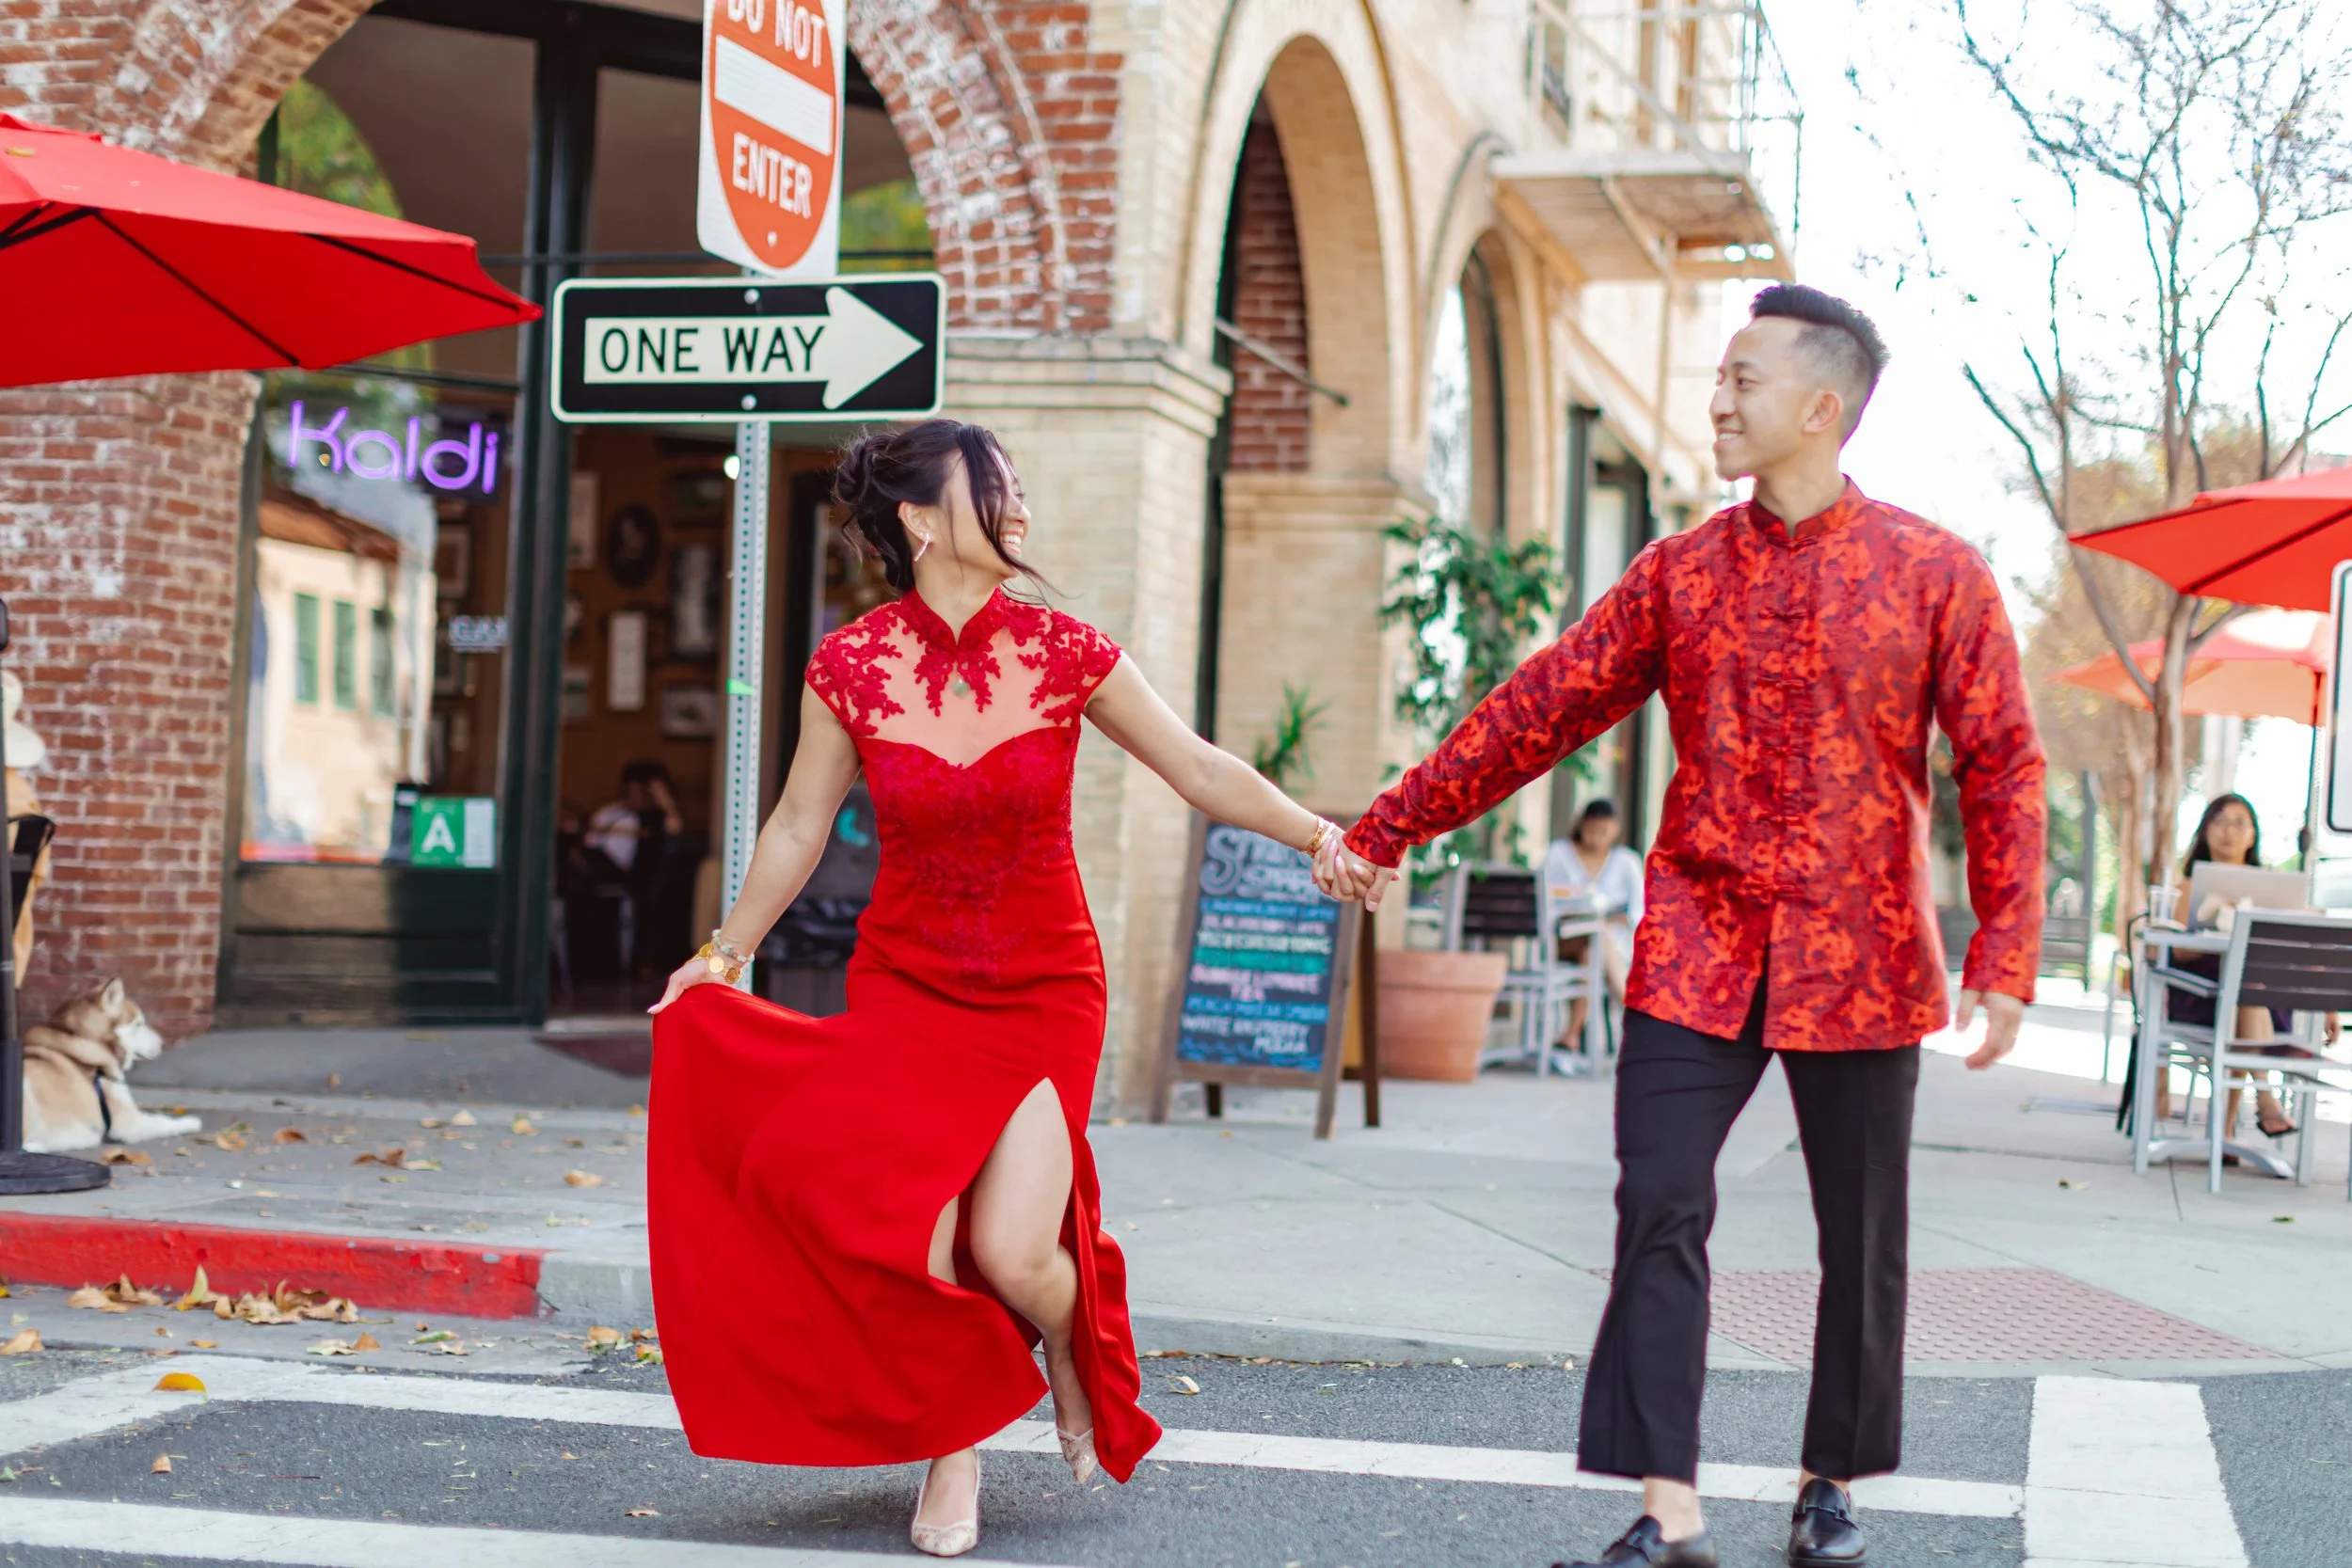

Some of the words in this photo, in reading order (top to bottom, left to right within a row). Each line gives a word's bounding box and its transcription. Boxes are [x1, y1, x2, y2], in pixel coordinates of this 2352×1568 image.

[775, 0, 825, 68] NOT
[732, 132, 813, 219] ENTER
[599, 327, 699, 373] ONE
[723, 325, 825, 373] WAY
[287, 400, 499, 494] Kaldi
[421, 812, 456, 854] A
